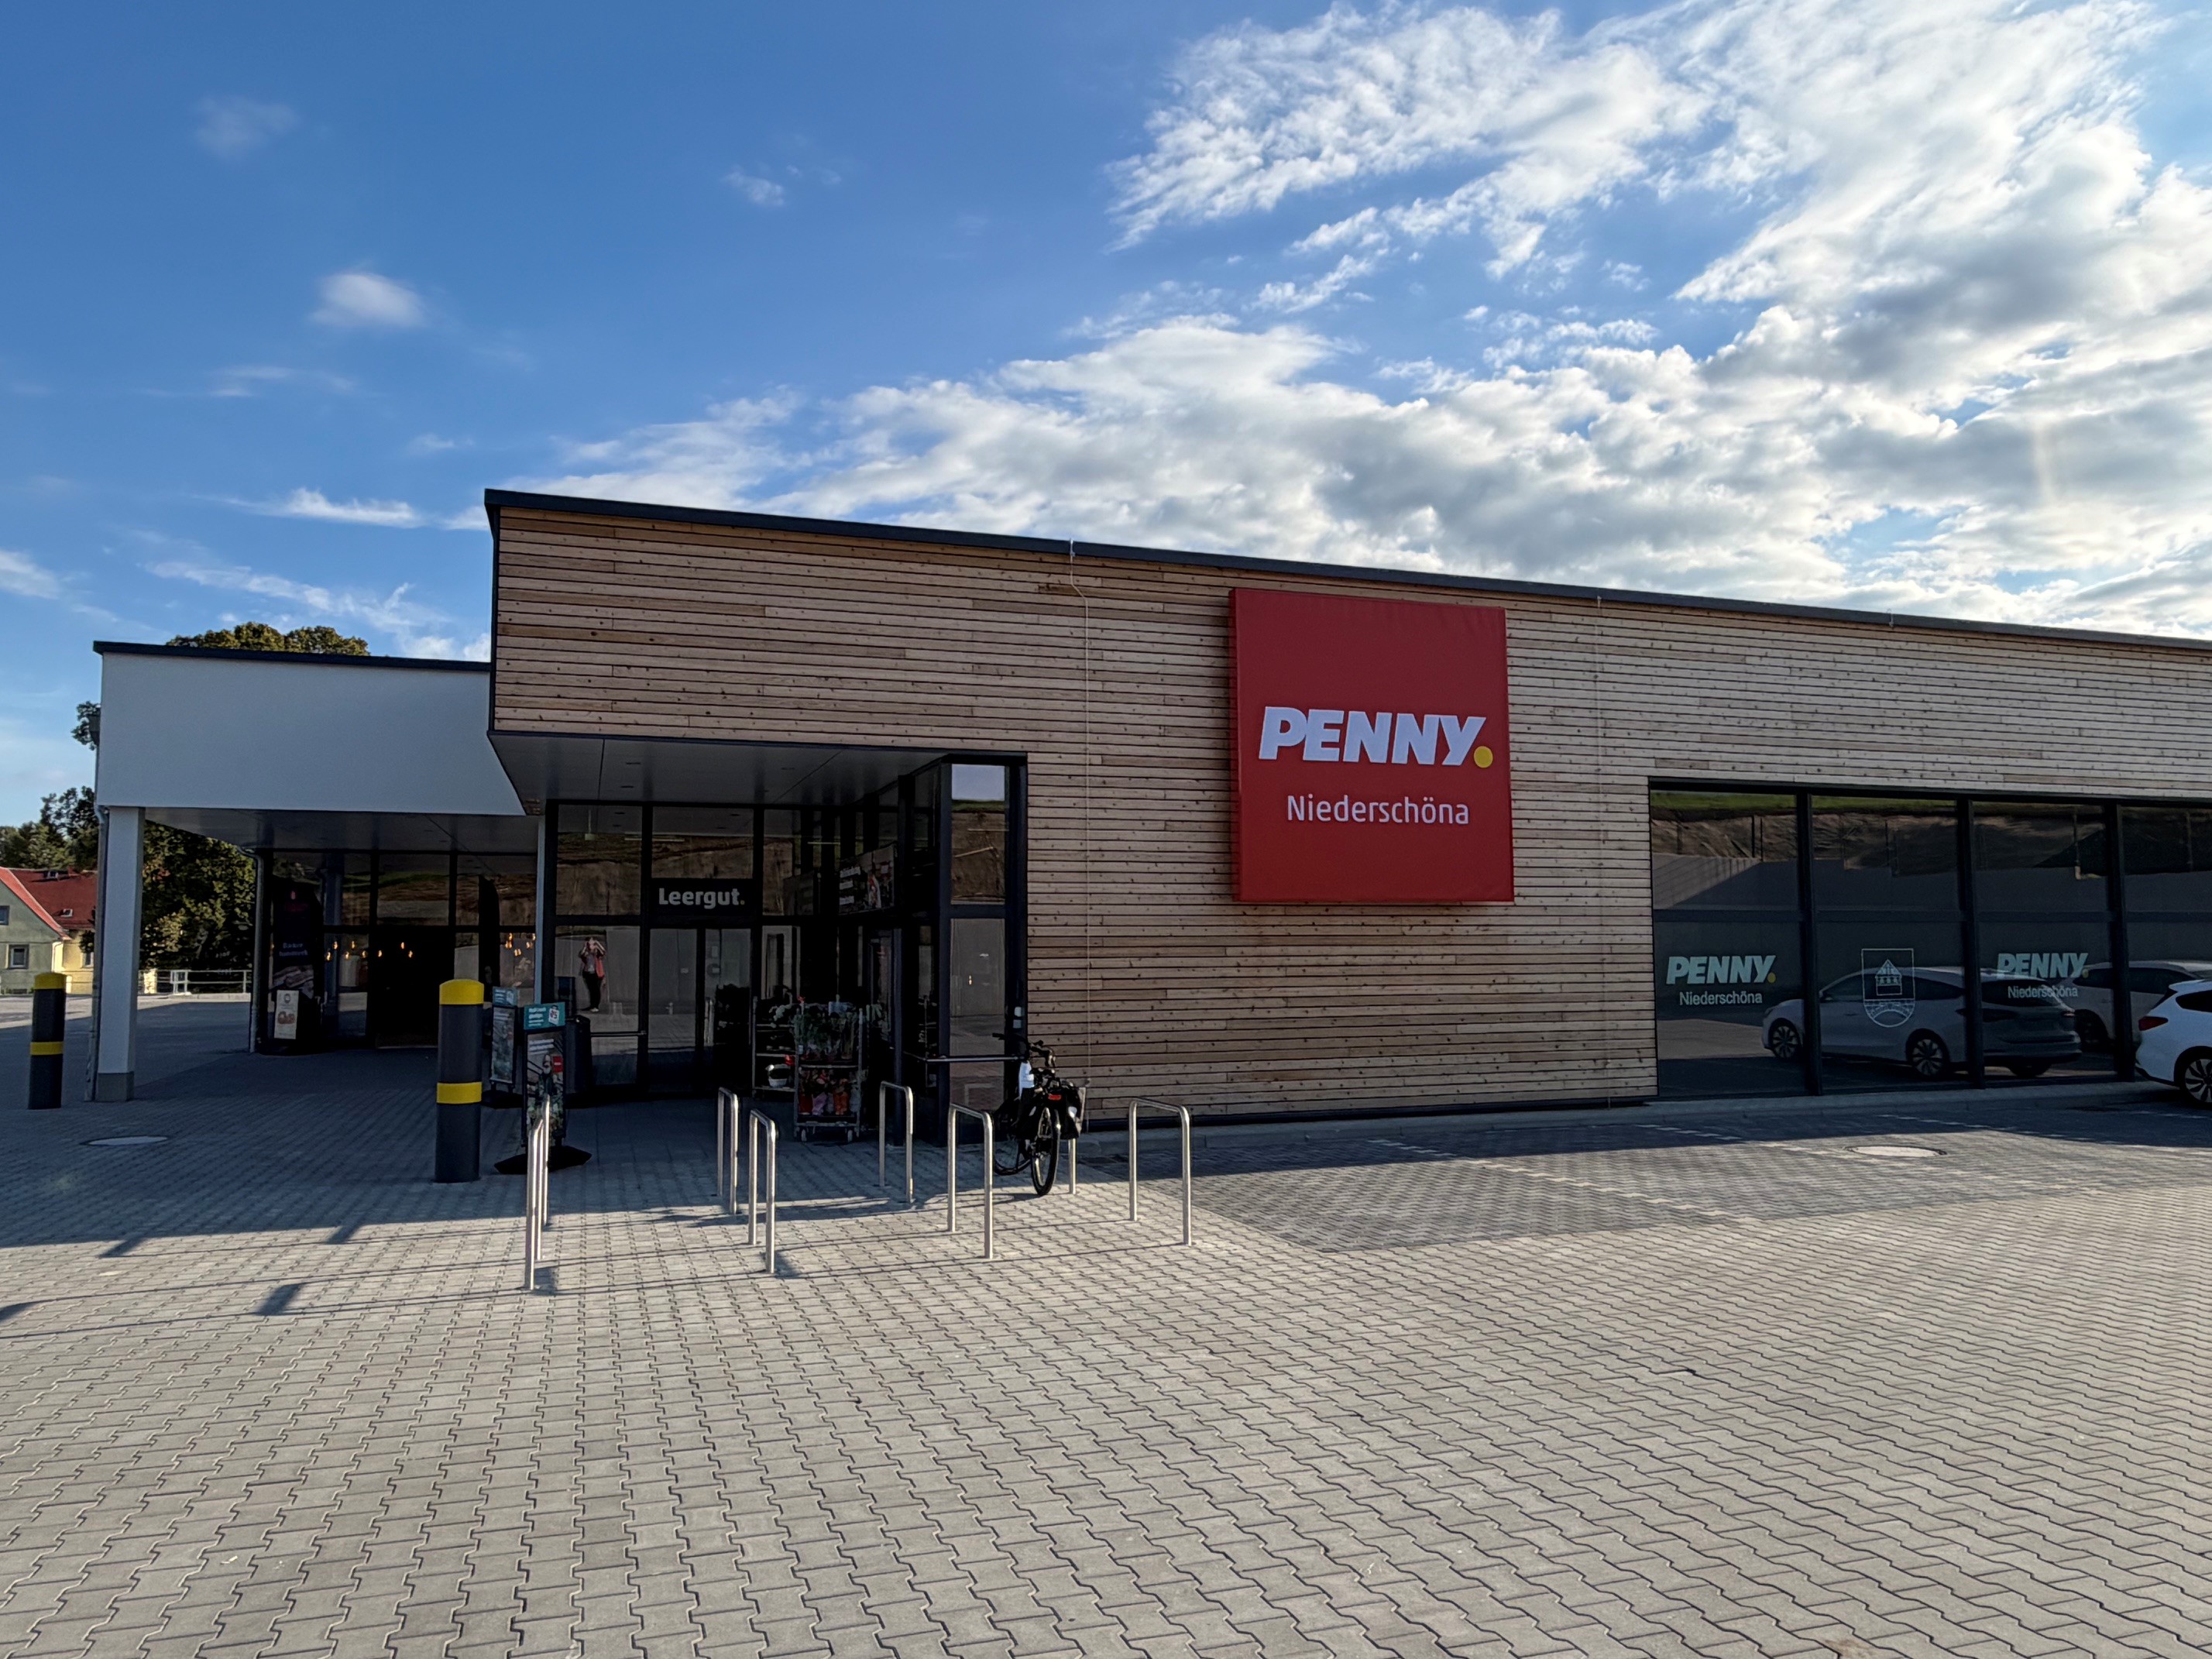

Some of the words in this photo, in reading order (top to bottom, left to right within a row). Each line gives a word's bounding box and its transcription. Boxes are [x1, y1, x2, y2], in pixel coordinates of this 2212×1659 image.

[1286, 793, 1469, 825] Niederschöna
[1679, 991, 1763, 1006] Niederschöna
[2008, 984, 2079, 999] Niederschöna
